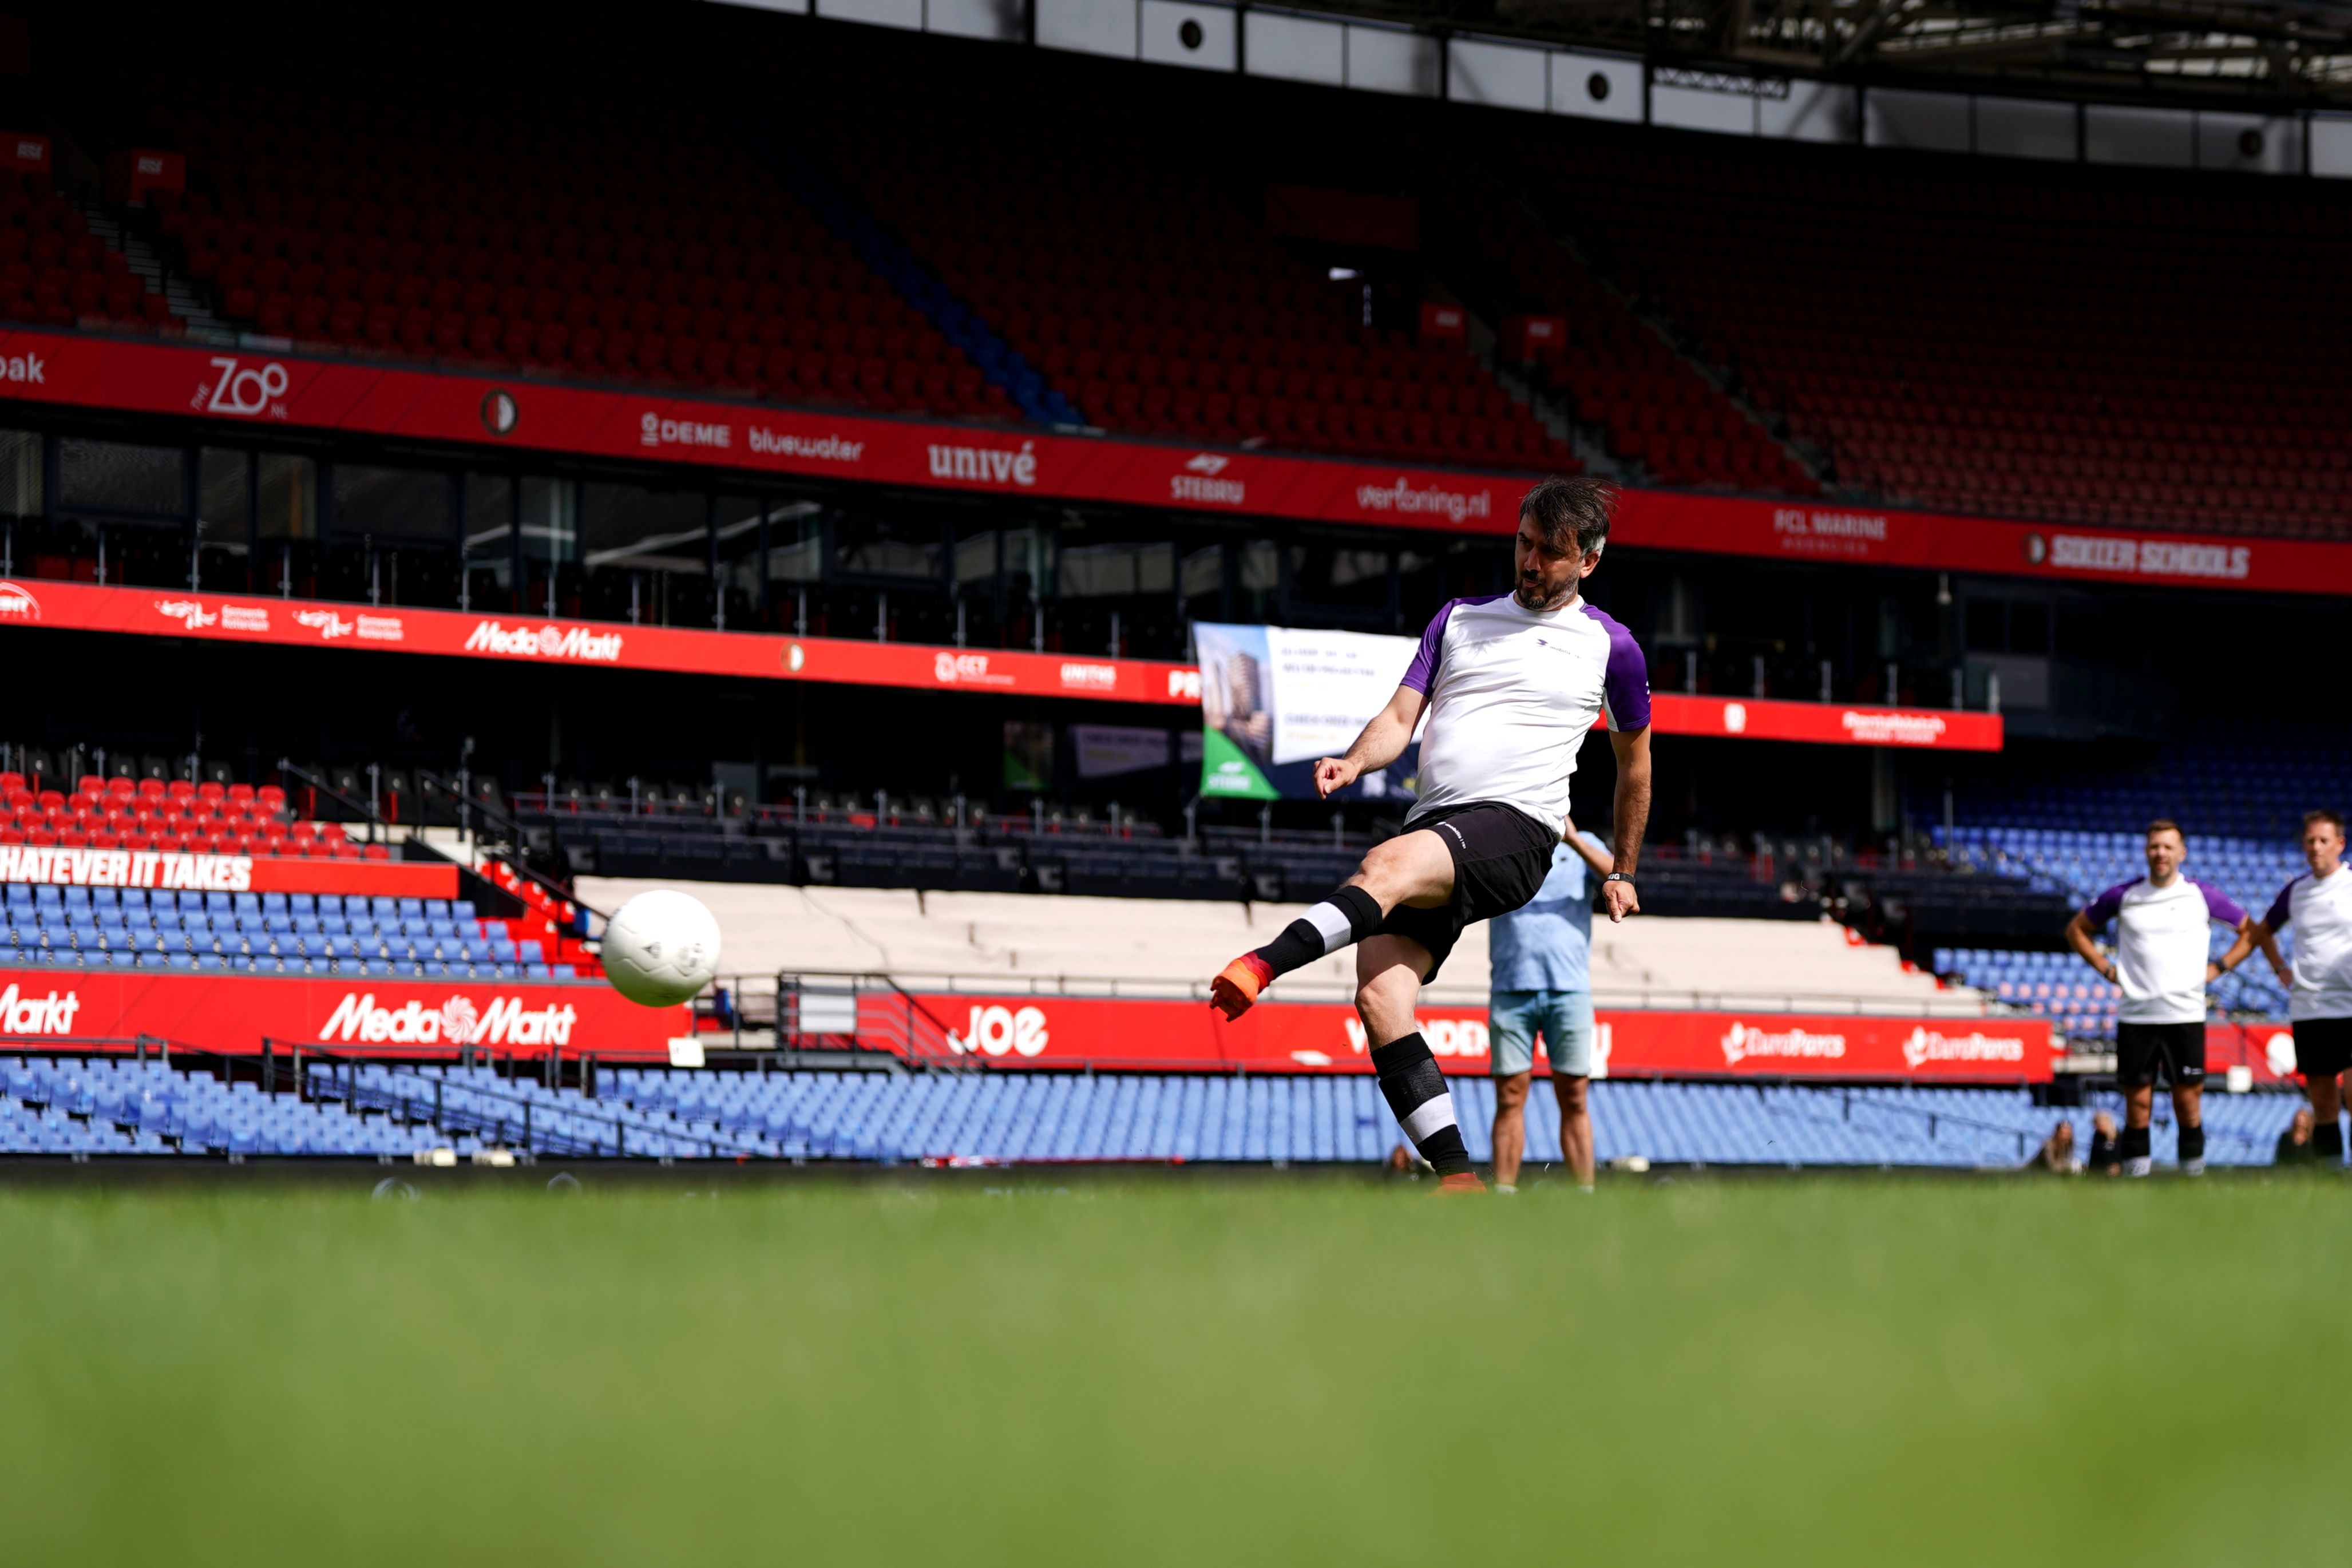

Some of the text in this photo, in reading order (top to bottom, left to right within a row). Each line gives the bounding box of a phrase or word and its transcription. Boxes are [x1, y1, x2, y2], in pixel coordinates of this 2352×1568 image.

[662, 419, 731, 448] DEME
[749, 426, 863, 461] bluewater
[928, 441, 1036, 486] univé
[1171, 474, 1245, 505] STEBRU
[1812, 512, 1887, 540] MARINE
[2139, 540, 2250, 580] SCHOOLS
[0, 845, 252, 891] HATEVER IT TAKES
[319, 992, 577, 1046] Media Markt
